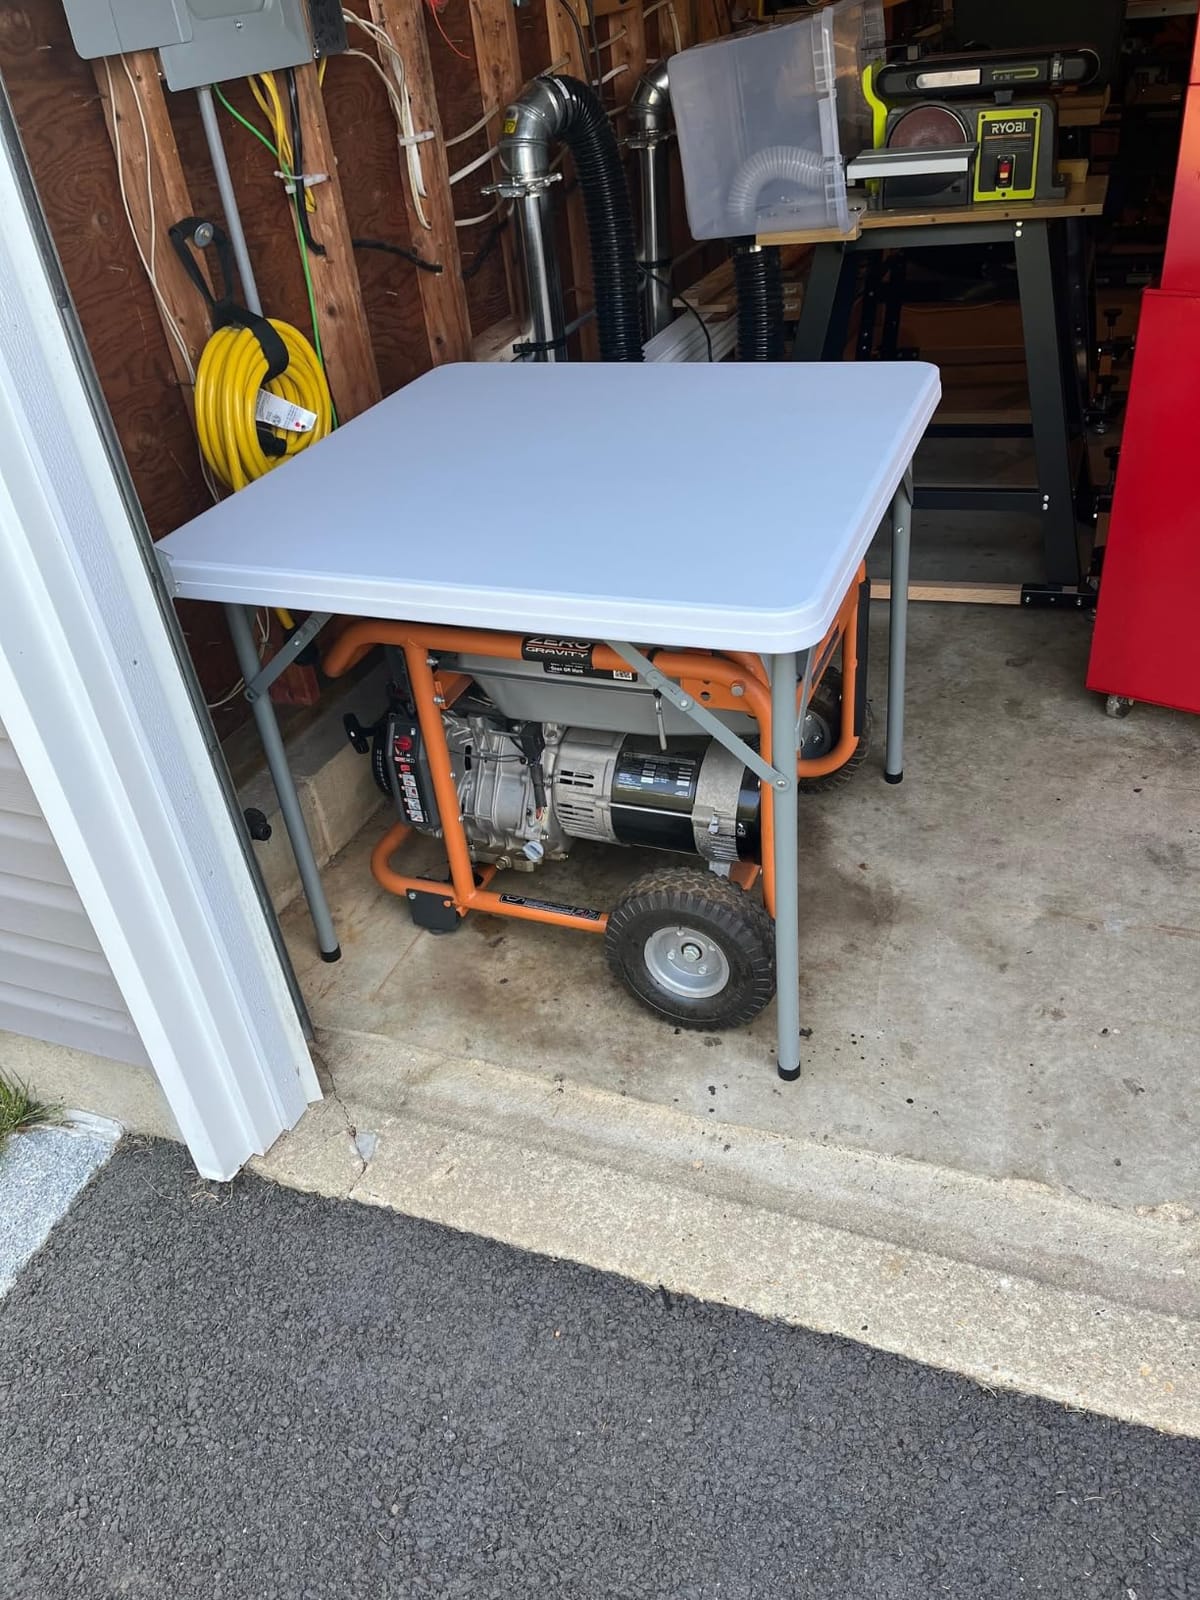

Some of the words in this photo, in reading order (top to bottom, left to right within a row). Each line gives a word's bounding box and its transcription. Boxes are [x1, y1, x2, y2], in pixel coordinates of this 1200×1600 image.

[991, 121, 1026, 134] RYOBI
[527, 637, 592, 649] ZERO
[525, 646, 588, 658] GRAVITY
